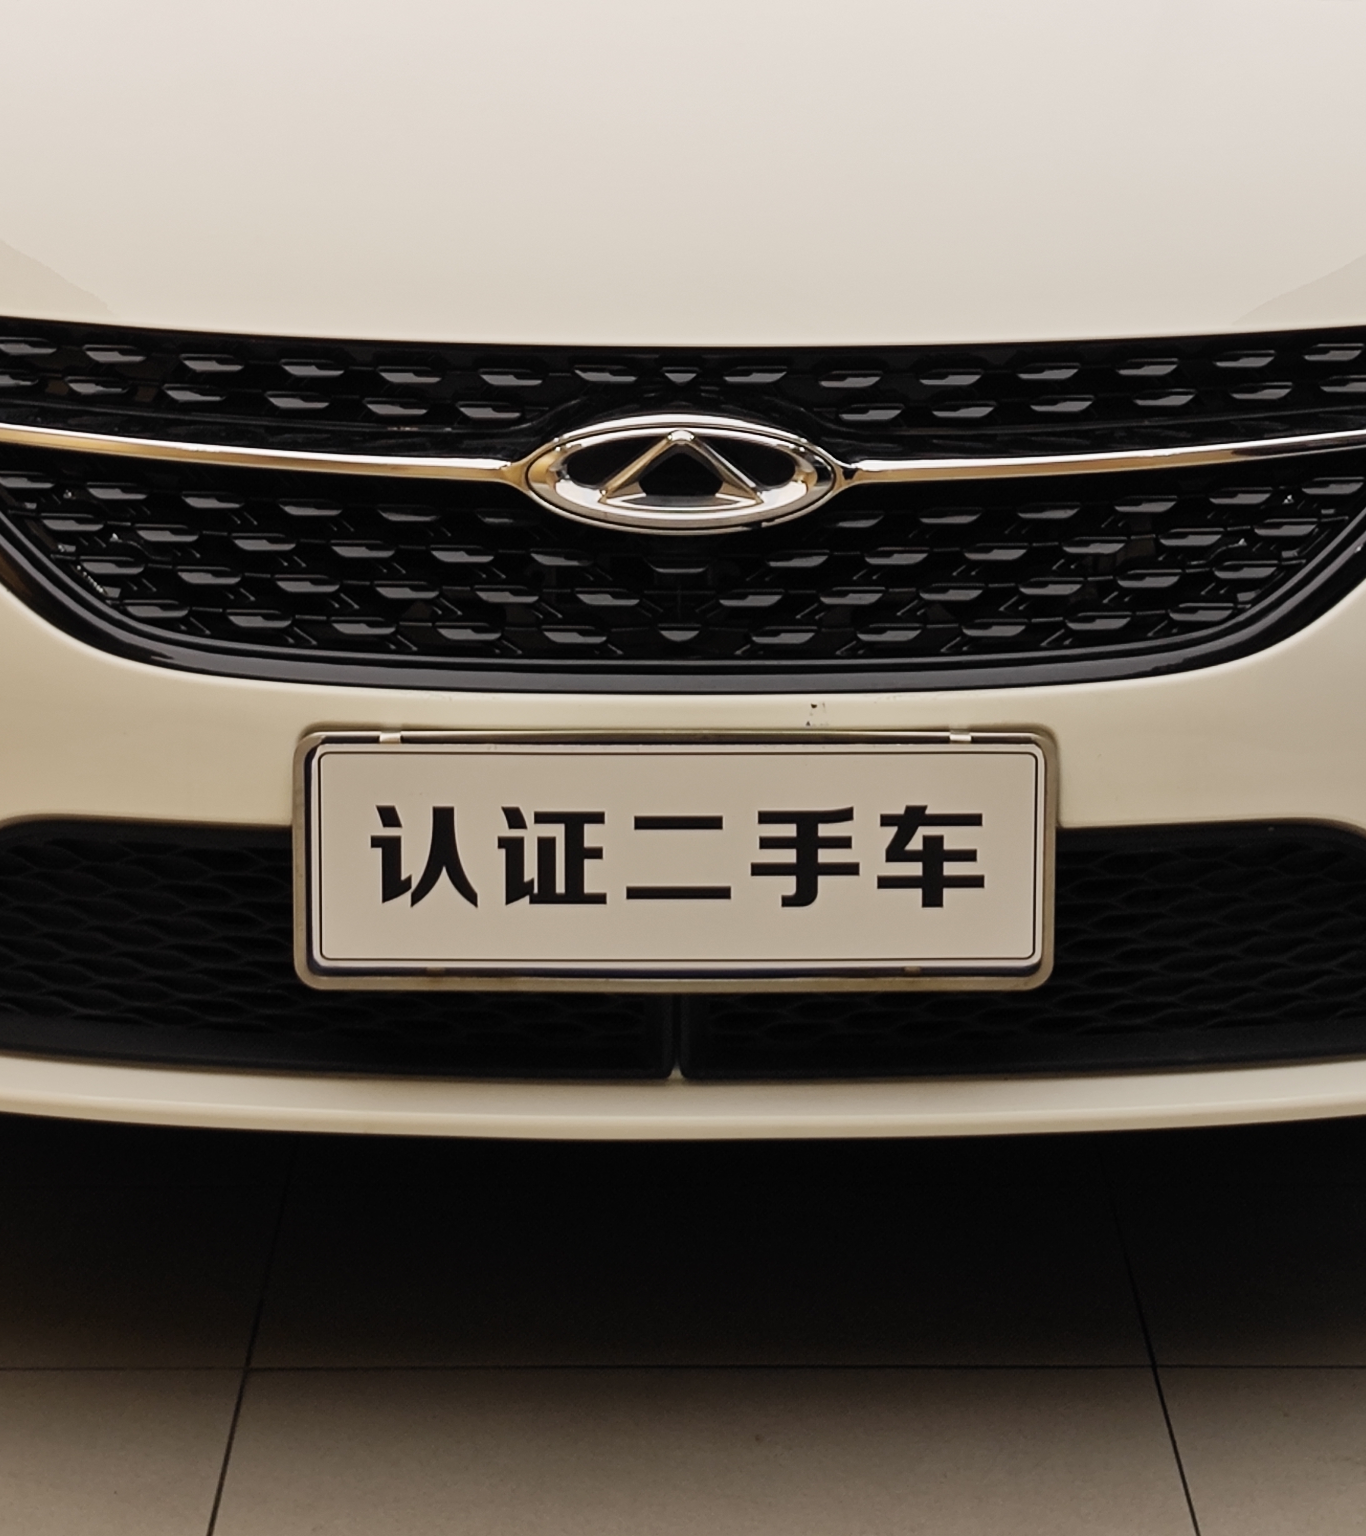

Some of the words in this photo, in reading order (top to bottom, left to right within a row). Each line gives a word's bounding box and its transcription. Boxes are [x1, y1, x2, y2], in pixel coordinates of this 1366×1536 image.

[370, 804, 985, 908] 认证二手车
